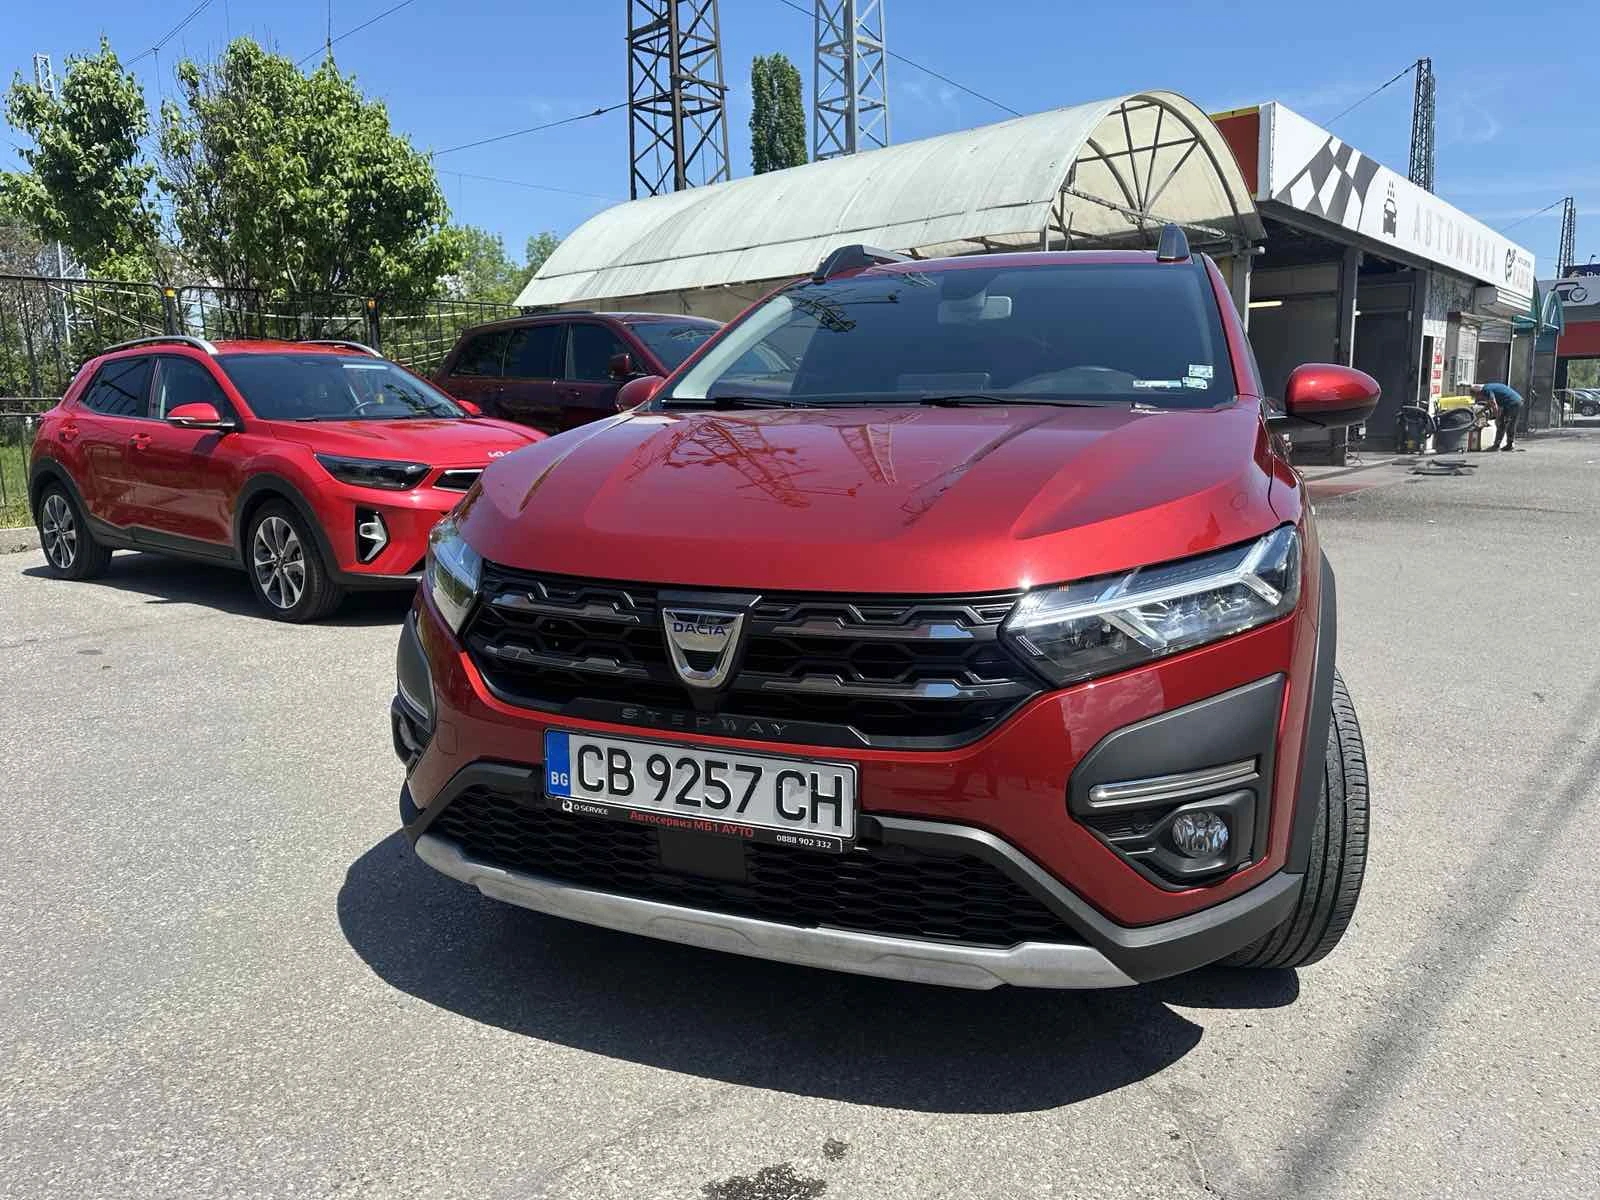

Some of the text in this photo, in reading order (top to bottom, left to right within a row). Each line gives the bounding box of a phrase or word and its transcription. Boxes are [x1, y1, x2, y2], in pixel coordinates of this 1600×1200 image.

[673, 622, 726, 636] DACIA
[620, 707, 788, 737] STEPWAY
[550, 771, 569, 787] BG
[576, 745, 843, 827] CB 9257 CH
[580, 804, 609, 816] SERVICE
[629, 810, 692, 829] Автосервиз
[776, 834, 832, 849] 0888 902 332
